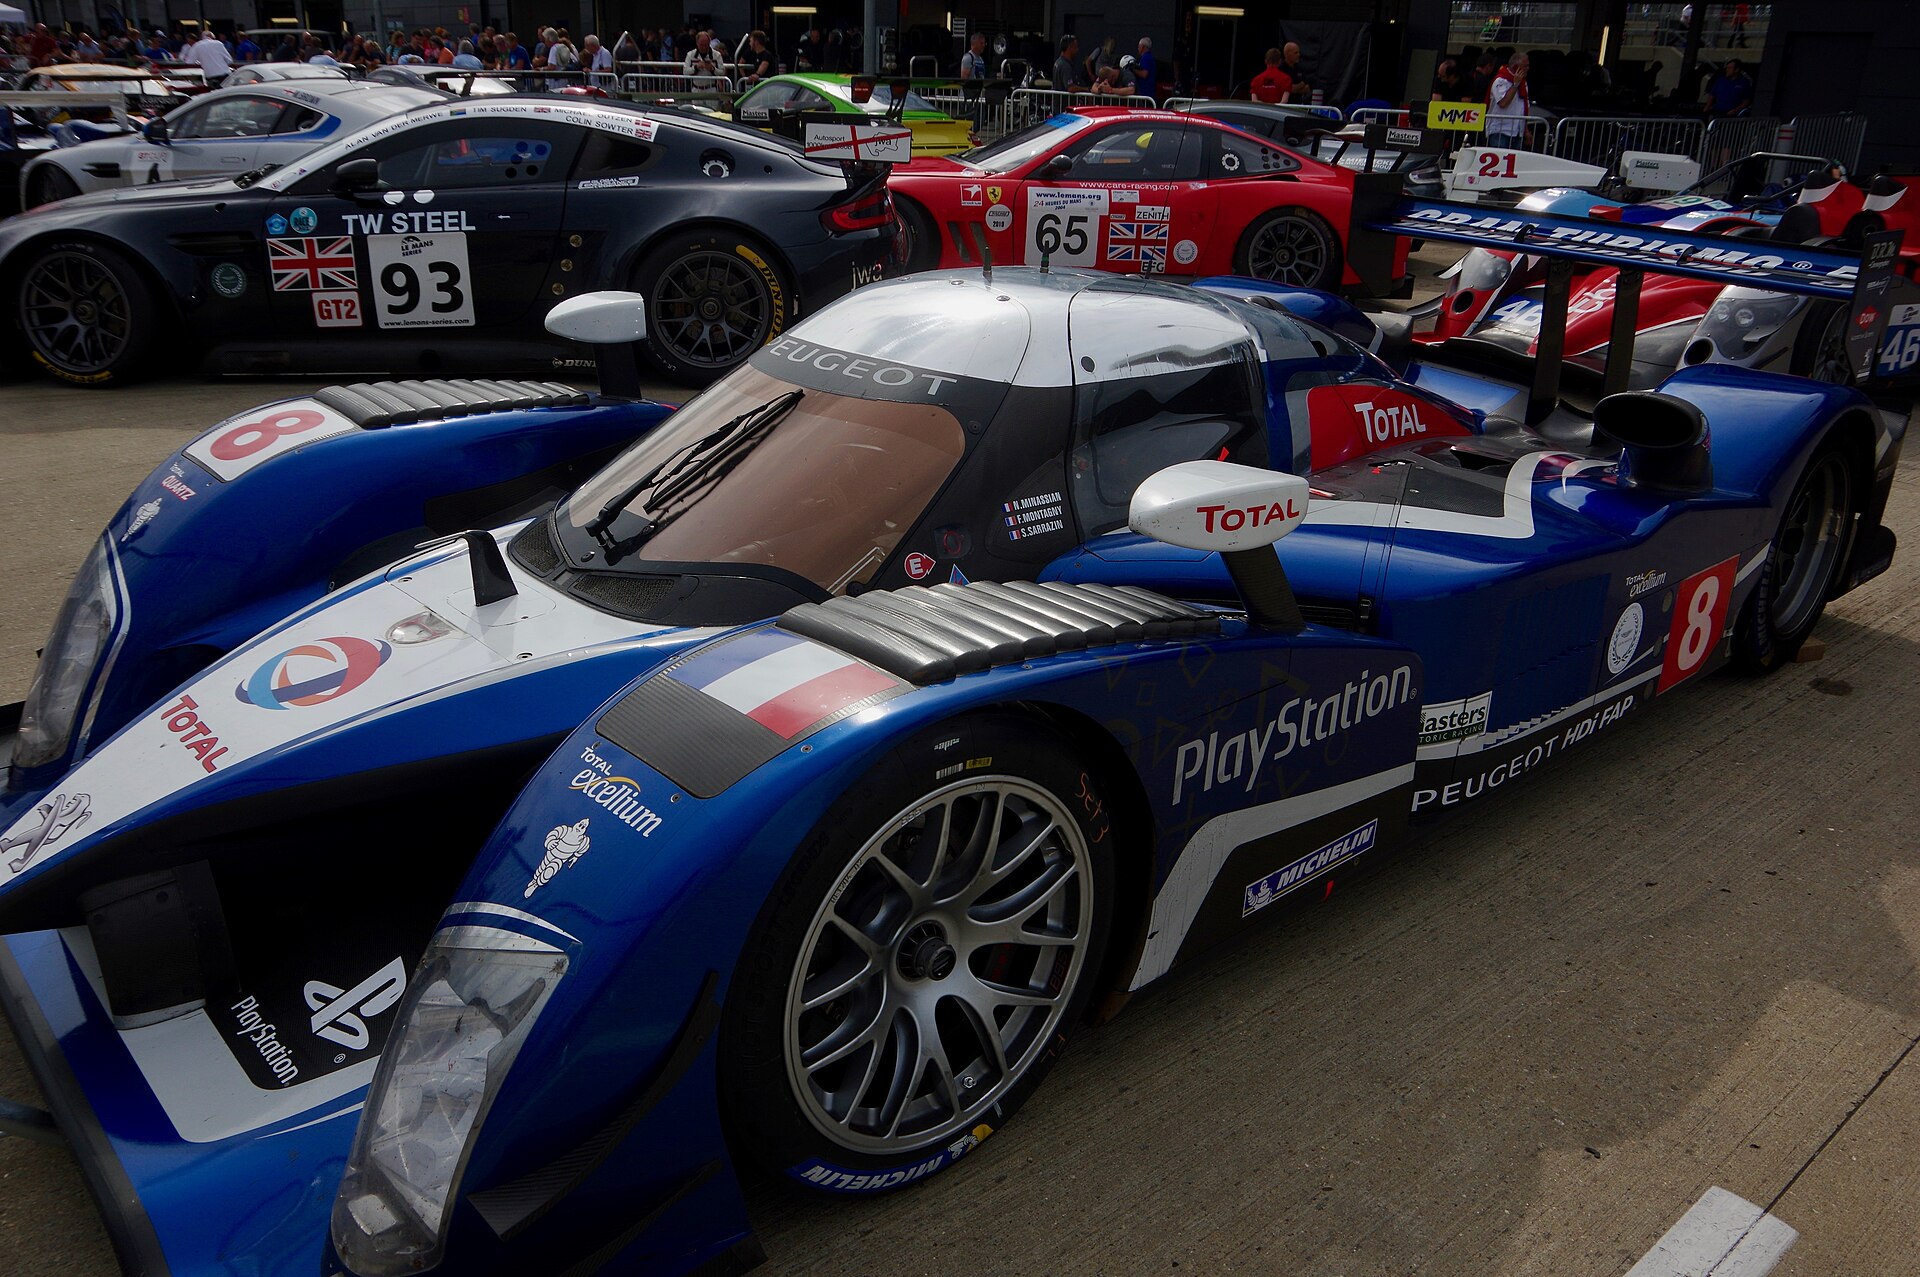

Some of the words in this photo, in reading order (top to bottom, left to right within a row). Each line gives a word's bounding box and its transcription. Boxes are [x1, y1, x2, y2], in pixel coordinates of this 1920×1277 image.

[565, 114, 592, 126] COLIN
[595, 121, 634, 139] SOWTER
[813, 134, 845, 143] Autosport
[1388, 130, 1419, 140] Masters
[1478, 152, 1517, 179] 21
[1035, 192, 1102, 201] www.lemans.org
[1079, 182, 1179, 191] www.care-racing.com
[341, 214, 384, 236] TW
[391, 211, 477, 233] STEEL
[1137, 210, 1169, 220] ZENITH
[413, 241, 434, 251] MANS
[1036, 214, 1088, 255] 65
[402, 249, 423, 257] SERIES
[380, 261, 464, 315] 93
[850, 260, 884, 292] jwa
[316, 299, 358, 321] GT2
[384, 318, 470, 328] www.lemans-series.com
[1880, 328, 1920, 372] 46
[210, 409, 326, 461] 8
[1354, 401, 1427, 444] TOTAL
[160, 474, 197, 501] QUARTZ
[1012, 491, 1062, 511] N.MINASSIAN
[1016, 505, 1063, 525] F.MONTAGNY
[1196, 498, 1300, 534] TOTAL
[1020, 519, 1064, 538] S.SARRAZIN
[909, 557, 924, 575] E
[1626, 573, 1645, 586] TOTAL
[1630, 572, 1667, 598] excellium
[1677, 575, 1720, 672] 8
[161, 694, 229, 774] TOTAL
[1171, 665, 1413, 807] PlayStation
[1420, 732, 1450, 745] TORIC
[1451, 723, 1485, 739] RACING
[580, 746, 613, 776] TOTAL
[1410, 735, 1560, 813] PEUGEOT
[1560, 711, 1599, 751] HDi
[1598, 694, 1636, 731] FAP
[571, 768, 663, 837] excellium
[1275, 826, 1375, 892] MICHELIN
[230, 995, 299, 1084] PlayStation
[801, 1155, 944, 1190] MICHELIN
